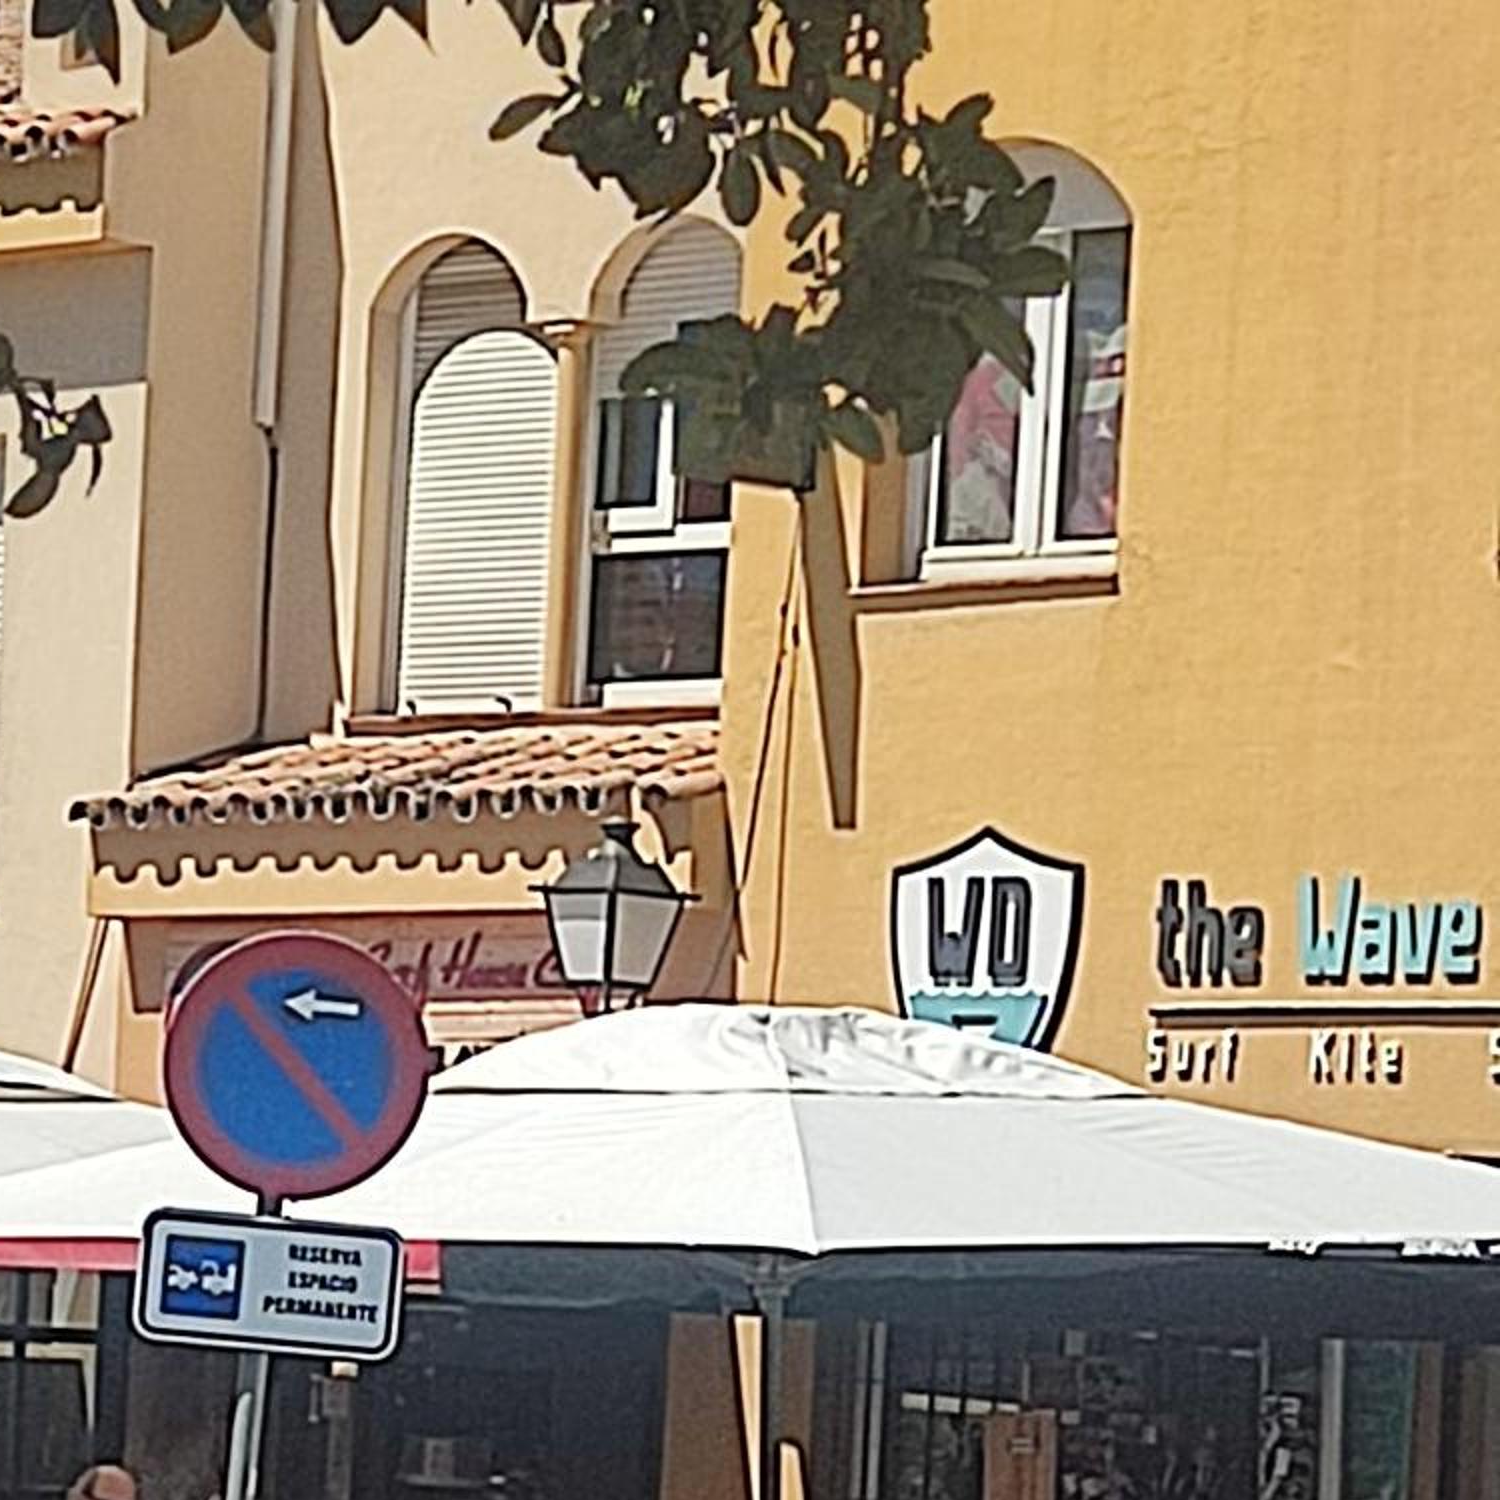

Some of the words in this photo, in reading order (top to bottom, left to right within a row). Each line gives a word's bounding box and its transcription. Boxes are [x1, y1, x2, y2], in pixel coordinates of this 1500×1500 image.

[1156, 879, 1264, 987] the
[1297, 874, 1481, 985] Wave
[1147, 1028, 1239, 1083] Surf
[1311, 1027, 1402, 1084] Kite
[288, 1244, 362, 1267] RESERVA
[287, 1271, 357, 1294] ESPACIO
[262, 1295, 379, 1324] PERMANENTE
